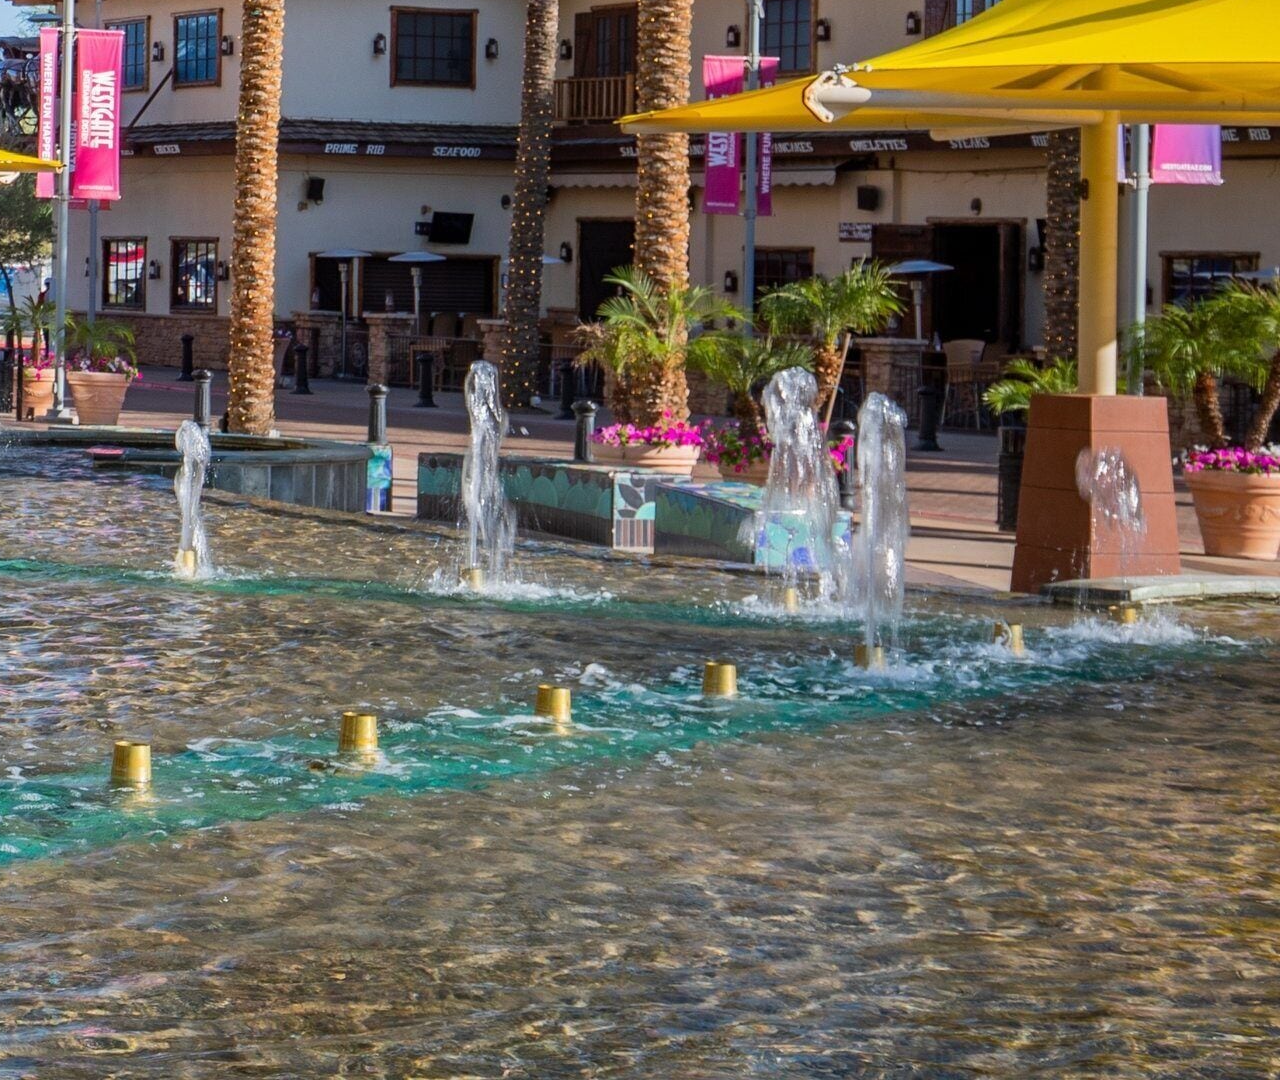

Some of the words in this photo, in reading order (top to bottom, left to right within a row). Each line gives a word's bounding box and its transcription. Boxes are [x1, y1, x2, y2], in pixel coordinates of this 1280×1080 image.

[42, 52, 54, 96] WHERE
[41, 97, 54, 119] FUN
[89, 70, 117, 149] WESTGATE
[762, 132, 772, 154] FUN
[948, 136, 991, 150] STEAKS
[1248, 127, 1272, 141] RIB
[324, 143, 359, 155] PRIME
[365, 144, 386, 156] RIB
[432, 145, 482, 158] SEAFOOD
[849, 138, 908, 152] OMELETTES
[760, 157, 771, 194] WHERE
